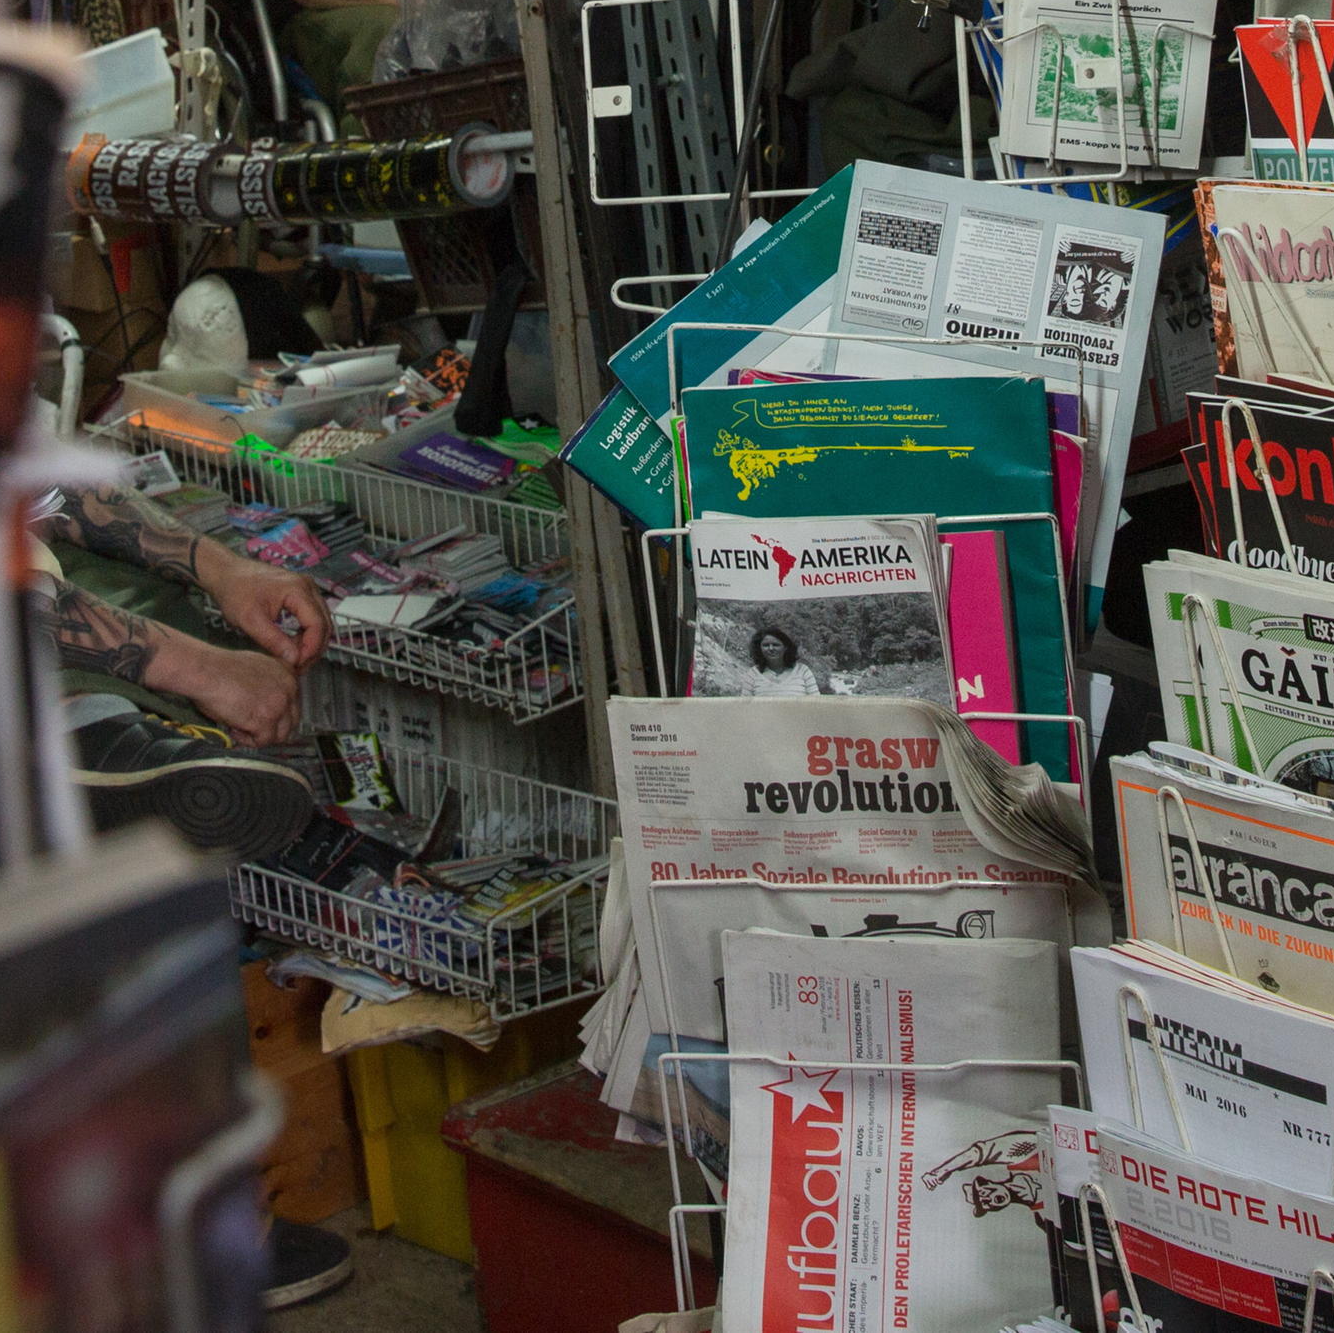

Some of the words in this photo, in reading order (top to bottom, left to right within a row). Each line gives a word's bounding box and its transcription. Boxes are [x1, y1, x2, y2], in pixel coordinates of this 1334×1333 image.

[1075, 0, 1090, 9] Ein
[851, 290, 927, 311] GESUNDHEITSDATEN
[883, 287, 912, 298] VORRAT
[913, 291, 929, 301] AUF
[1043, 328, 1115, 351] revolution
[599, 405, 639, 451] Logistik
[697, 548, 769, 570] LATEIN
[800, 544, 913, 569] AMERIKA
[801, 568, 916, 587] NACHRICHTEN
[630, 723, 646, 734] GWR
[647, 723, 662, 733] 410
[1238, 919, 1253, 936] IN
[1257, 925, 1281, 946] DIE
[798, 975, 819, 1005] 83
[853, 980, 863, 1012] REISEN:
[898, 989, 917, 1146] INTERNATINALISMUS!
[1185, 1082, 1208, 1103] MAI
[1216, 1096, 1247, 1119] 2016
[1282, 1119, 1303, 1140] NR
[1307, 1129, 1331, 1147] 777
[1121, 1154, 1171, 1195] DIE
[1177, 1174, 1270, 1226] ROTE
[895, 1151, 915, 1290] PROLETARISCHEN
[851, 1223, 861, 1264] DAIMLER
[894, 1296, 909, 1328] DEN
